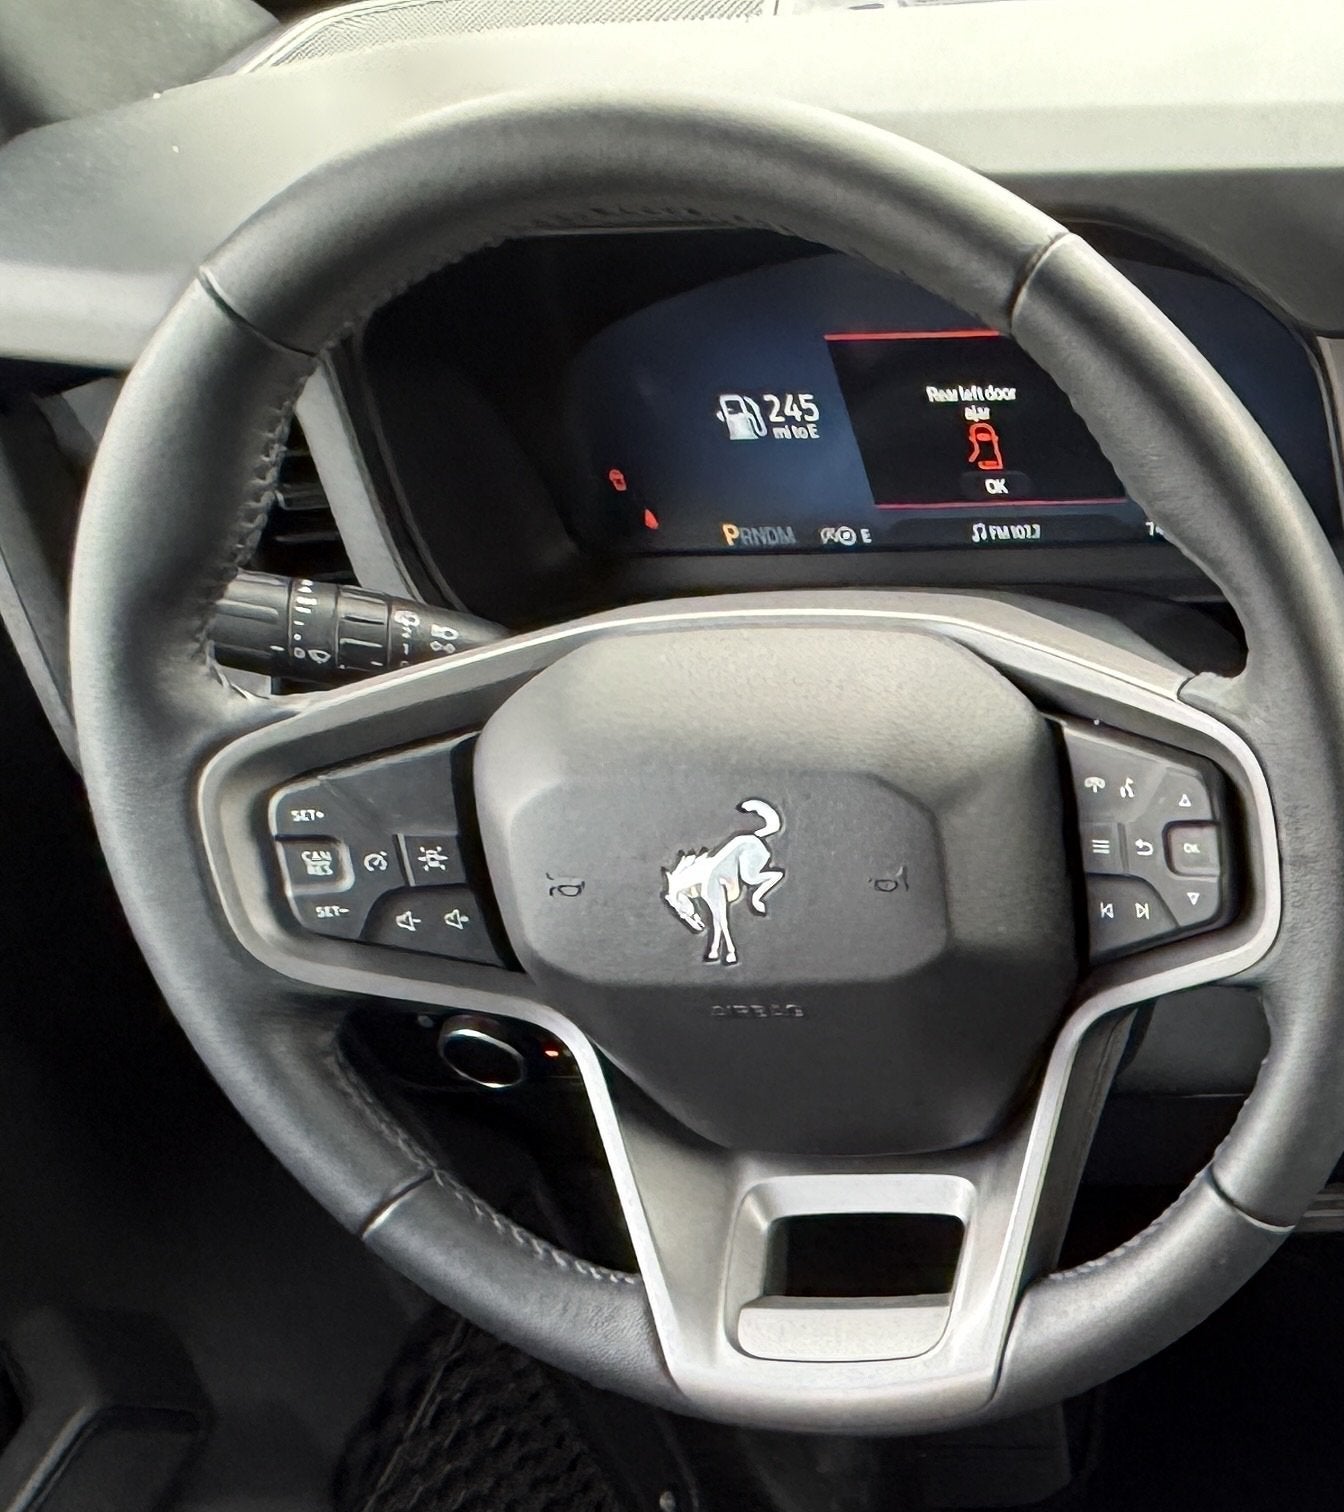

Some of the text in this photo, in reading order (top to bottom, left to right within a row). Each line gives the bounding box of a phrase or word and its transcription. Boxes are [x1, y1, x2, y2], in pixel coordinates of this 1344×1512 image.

[984, 384, 1017, 402] door
[763, 393, 820, 422] 245
[806, 423, 820, 440] E
[984, 478, 1009, 494] OK
[860, 528, 873, 544] E
